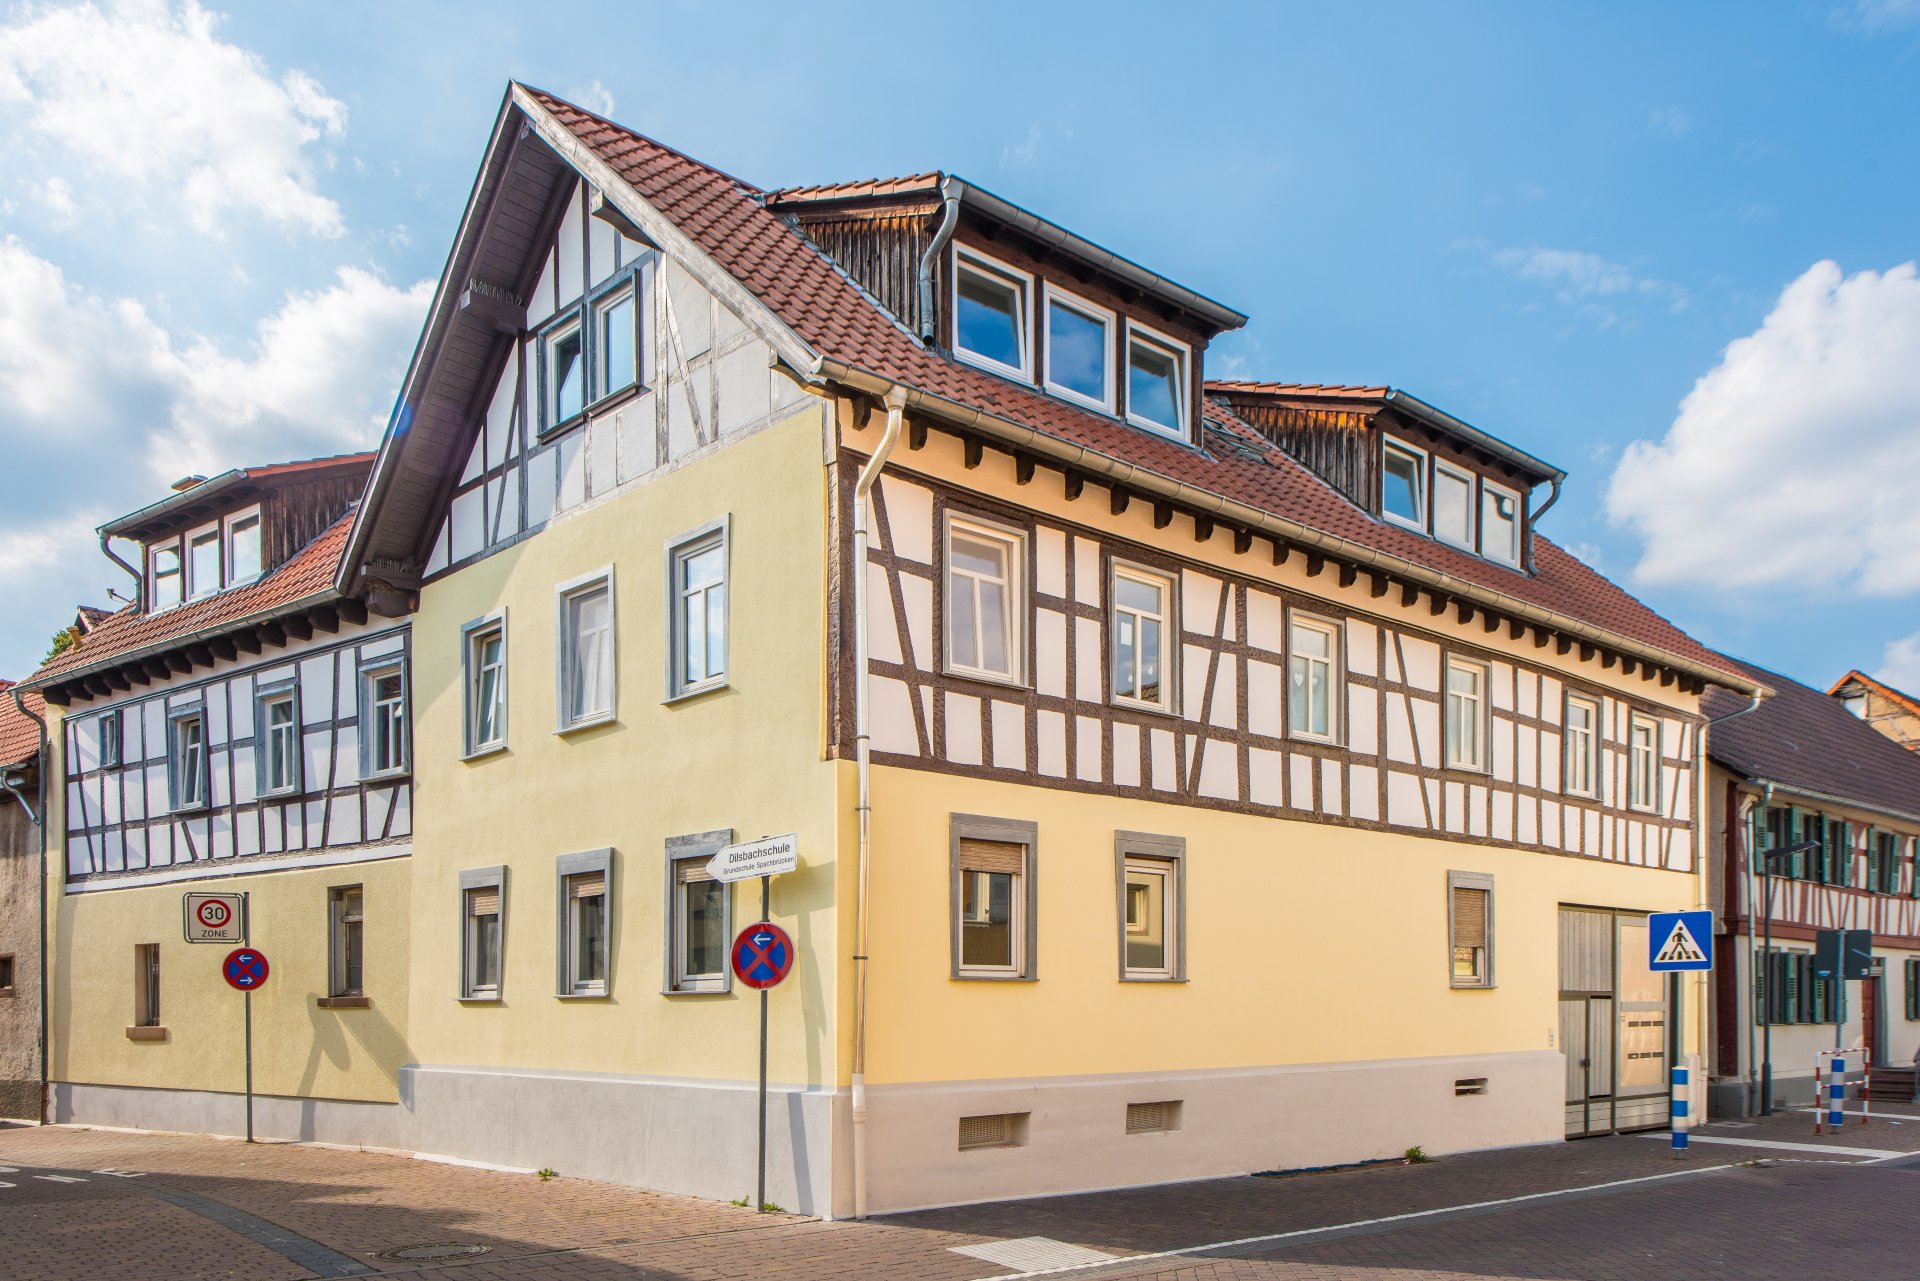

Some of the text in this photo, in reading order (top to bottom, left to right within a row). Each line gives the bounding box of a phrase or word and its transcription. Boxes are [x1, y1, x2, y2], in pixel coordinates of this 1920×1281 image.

[729, 843, 791, 864] Dilsbachschule
[723, 864, 755, 874] Grundschule
[204, 907, 224, 920] 30
